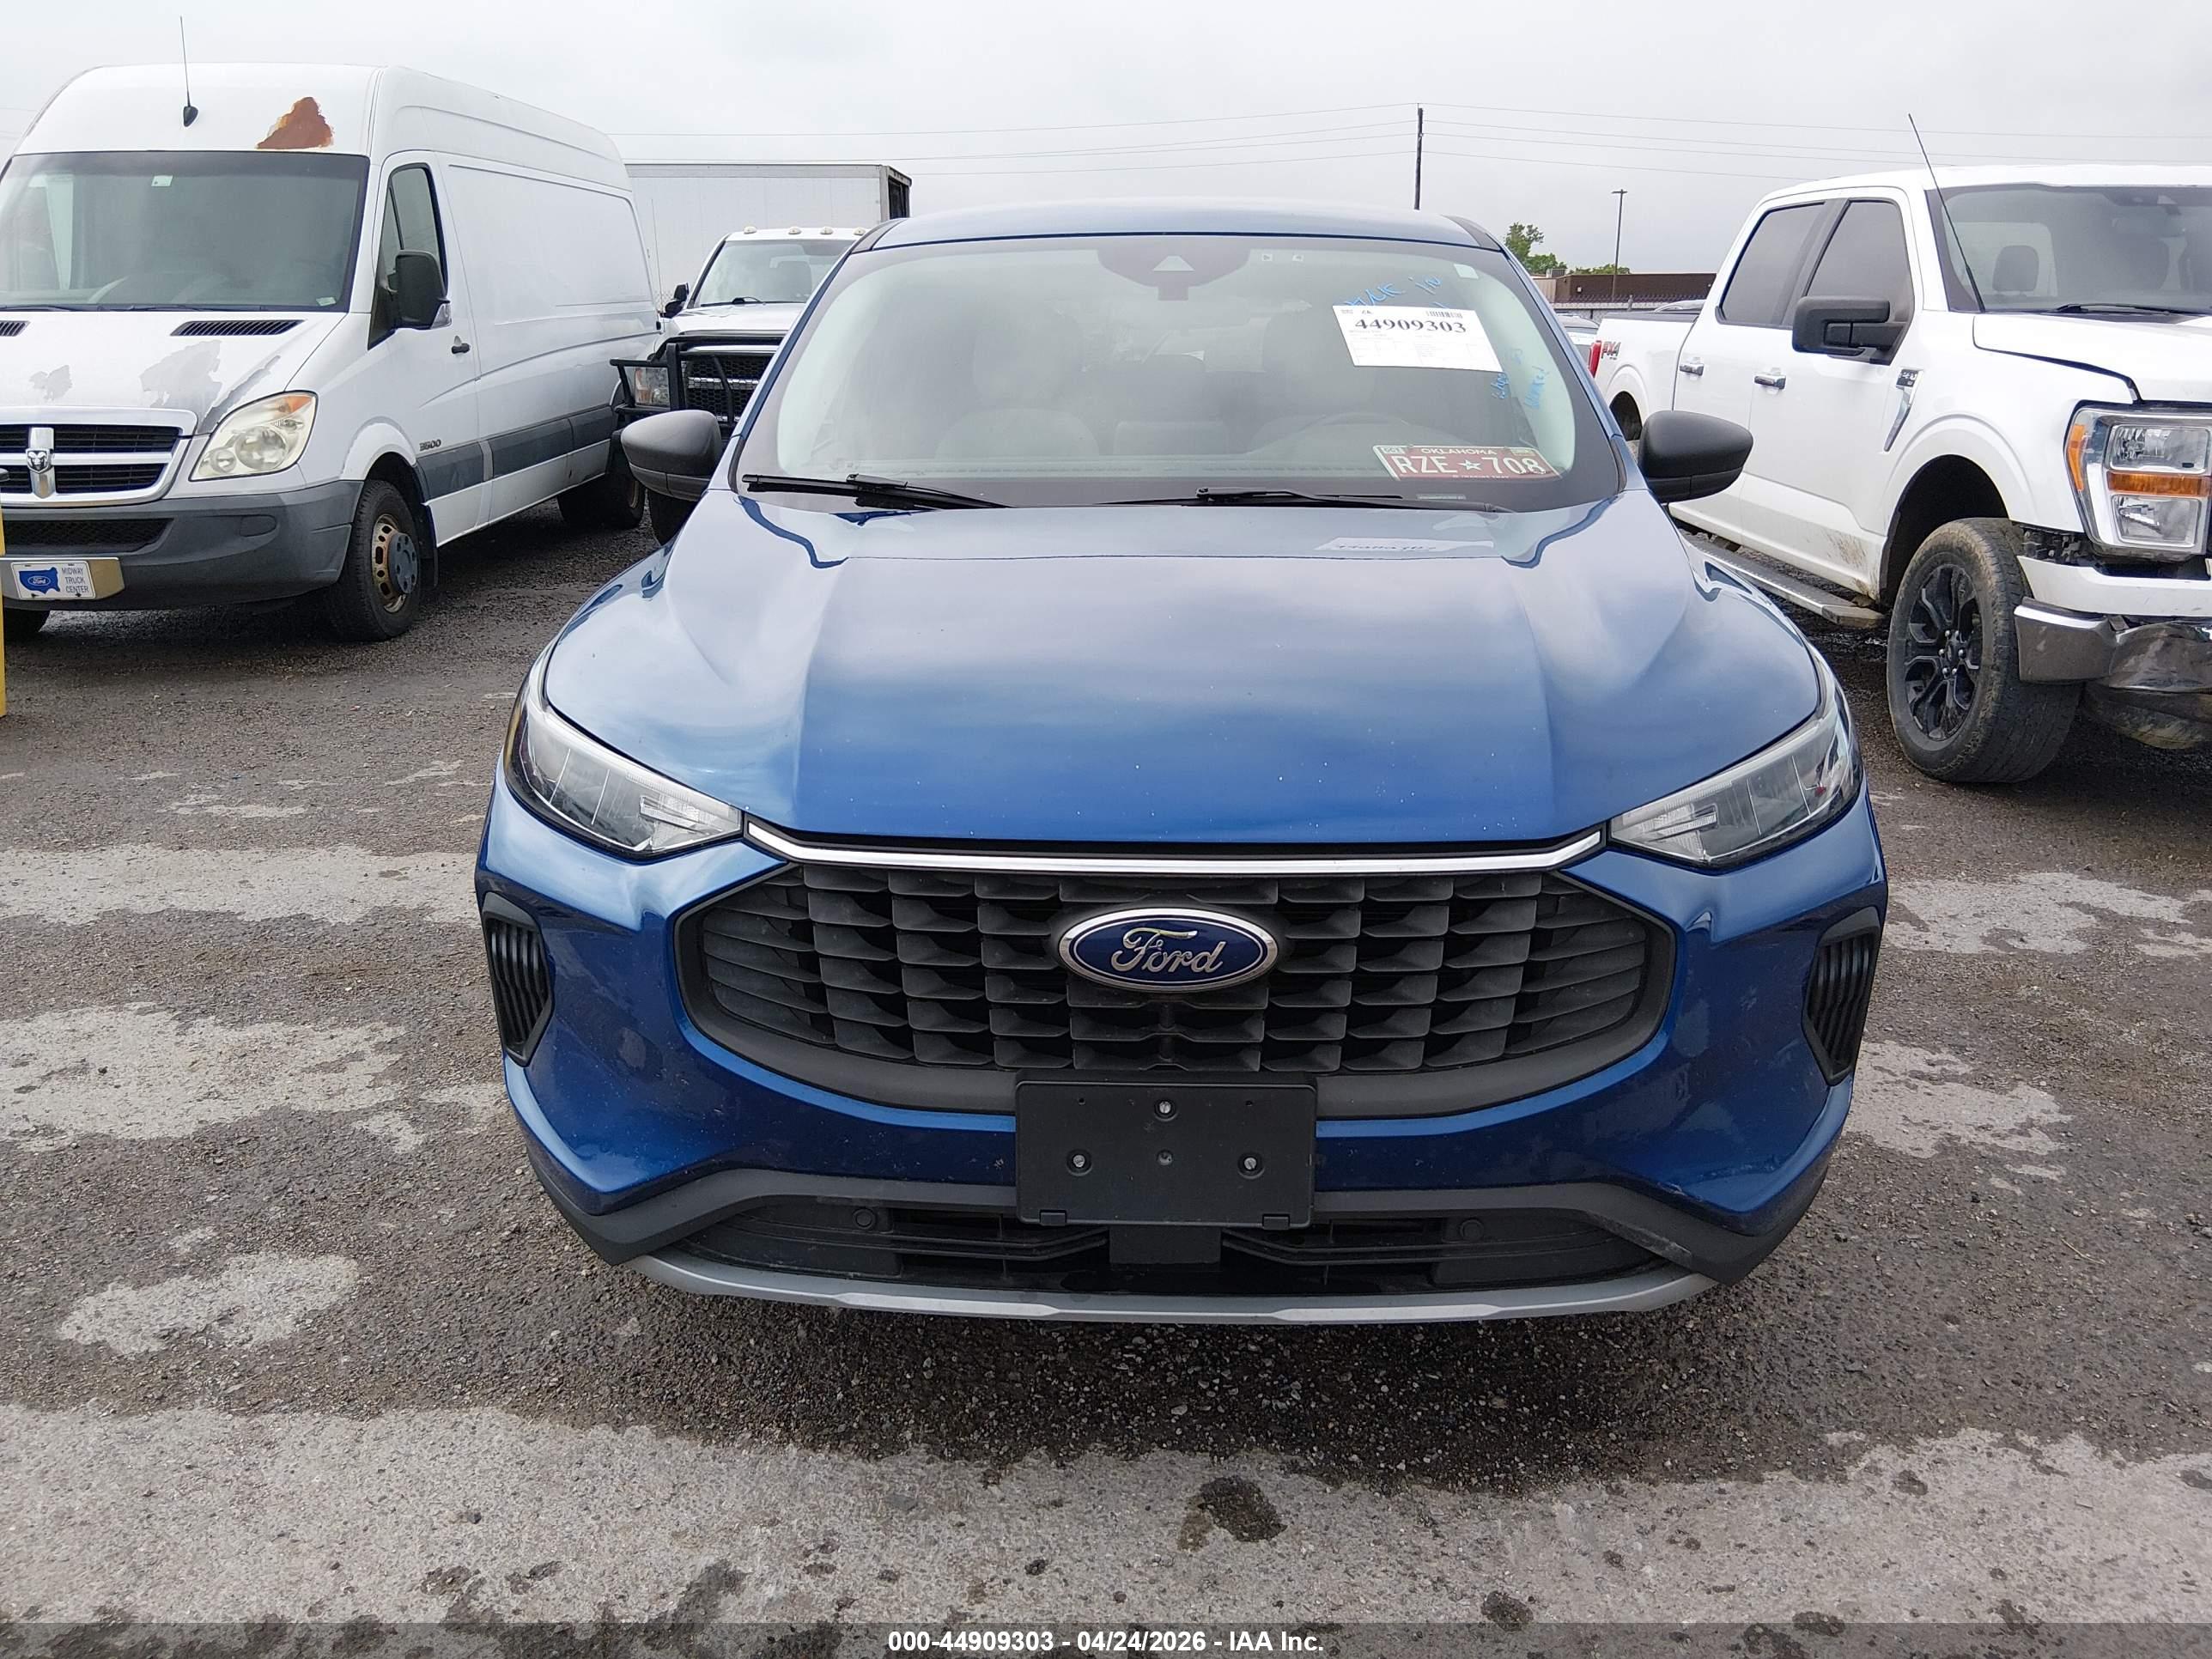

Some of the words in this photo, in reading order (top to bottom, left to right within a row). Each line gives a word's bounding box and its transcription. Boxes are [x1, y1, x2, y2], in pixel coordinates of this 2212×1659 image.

[1354, 319, 1468, 334] 44909303
[1601, 341, 1621, 359] FX4
[1420, 447, 1498, 456] OKLAHOMA
[1391, 455, 1458, 474] RZE
[1481, 456, 1547, 475] 708
[1110, 927, 1226, 974] Ford
